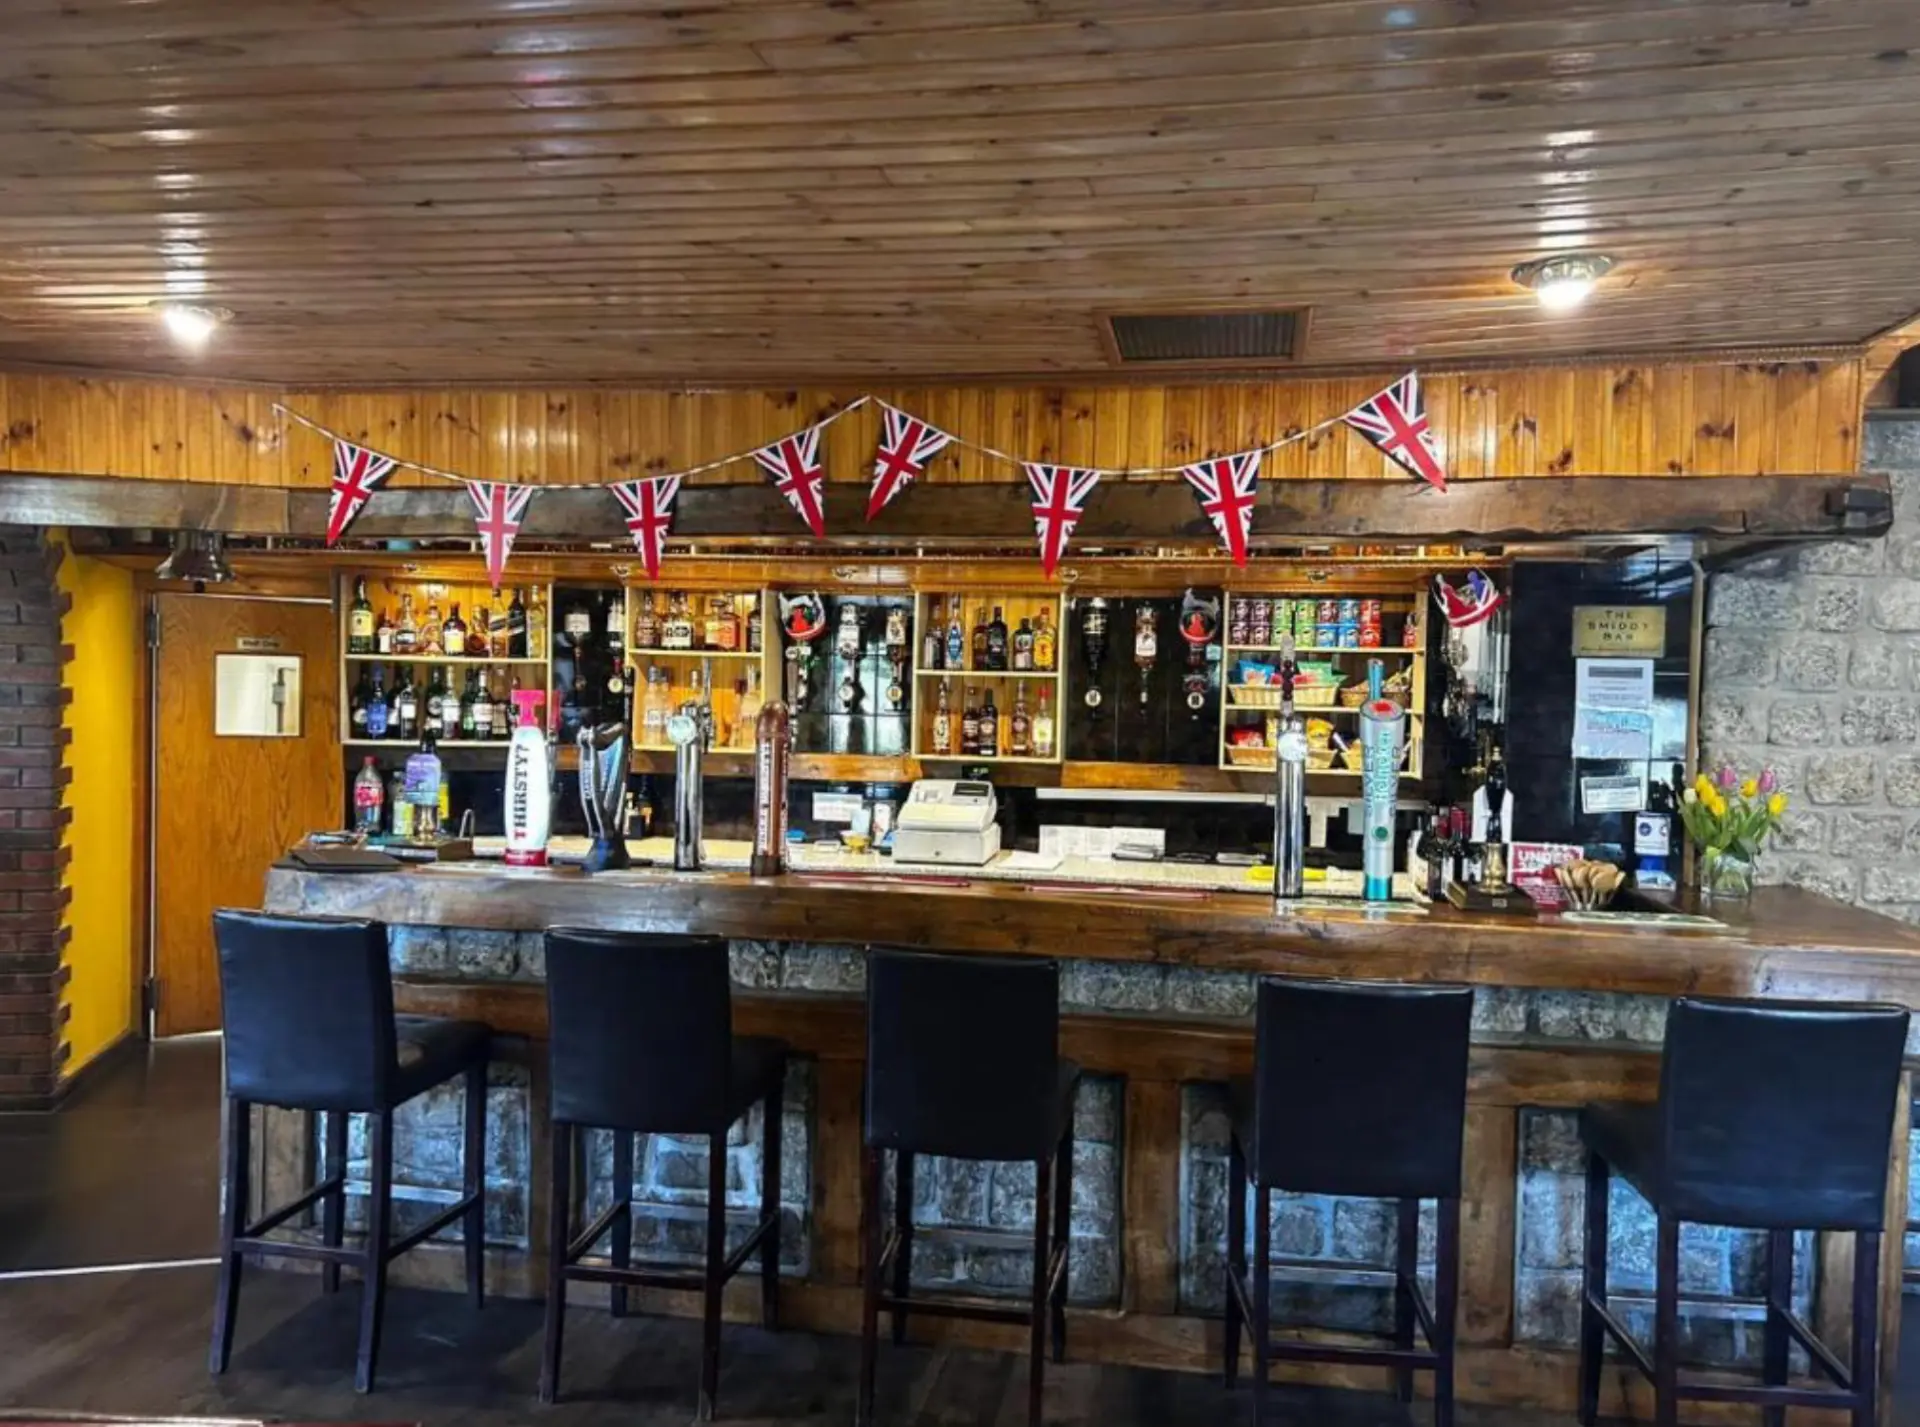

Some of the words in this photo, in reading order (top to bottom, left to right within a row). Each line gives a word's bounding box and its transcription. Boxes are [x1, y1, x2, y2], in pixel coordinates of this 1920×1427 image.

[1604, 609, 1632, 620] THE
[1602, 632, 1633, 641] BAR
[513, 743, 529, 841] THIRSTY?
